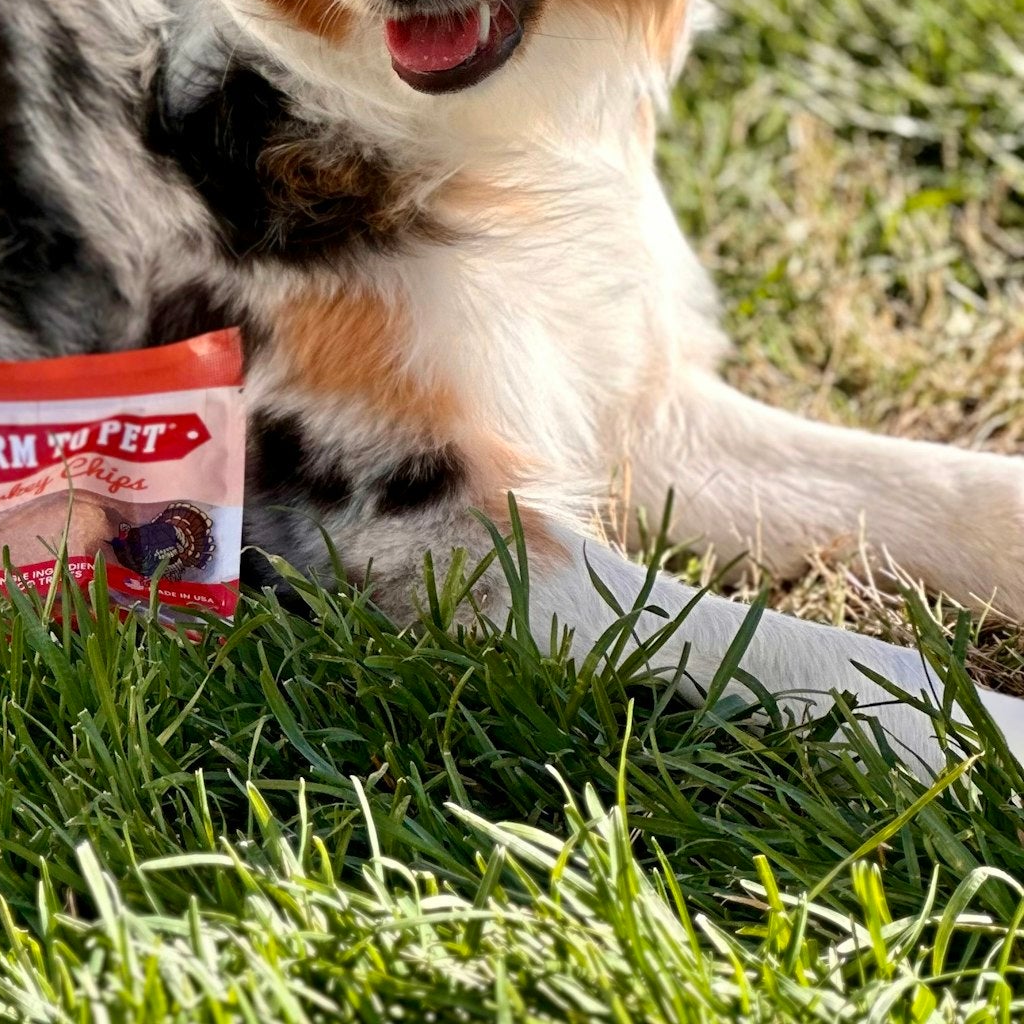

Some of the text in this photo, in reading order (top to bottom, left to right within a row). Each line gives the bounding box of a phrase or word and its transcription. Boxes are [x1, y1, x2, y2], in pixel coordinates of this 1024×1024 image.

[47, 427, 91, 458] TO
[97, 420, 166, 454] PET
[61, 457, 148, 492] Chips
[156, 589, 177, 597] ADE
